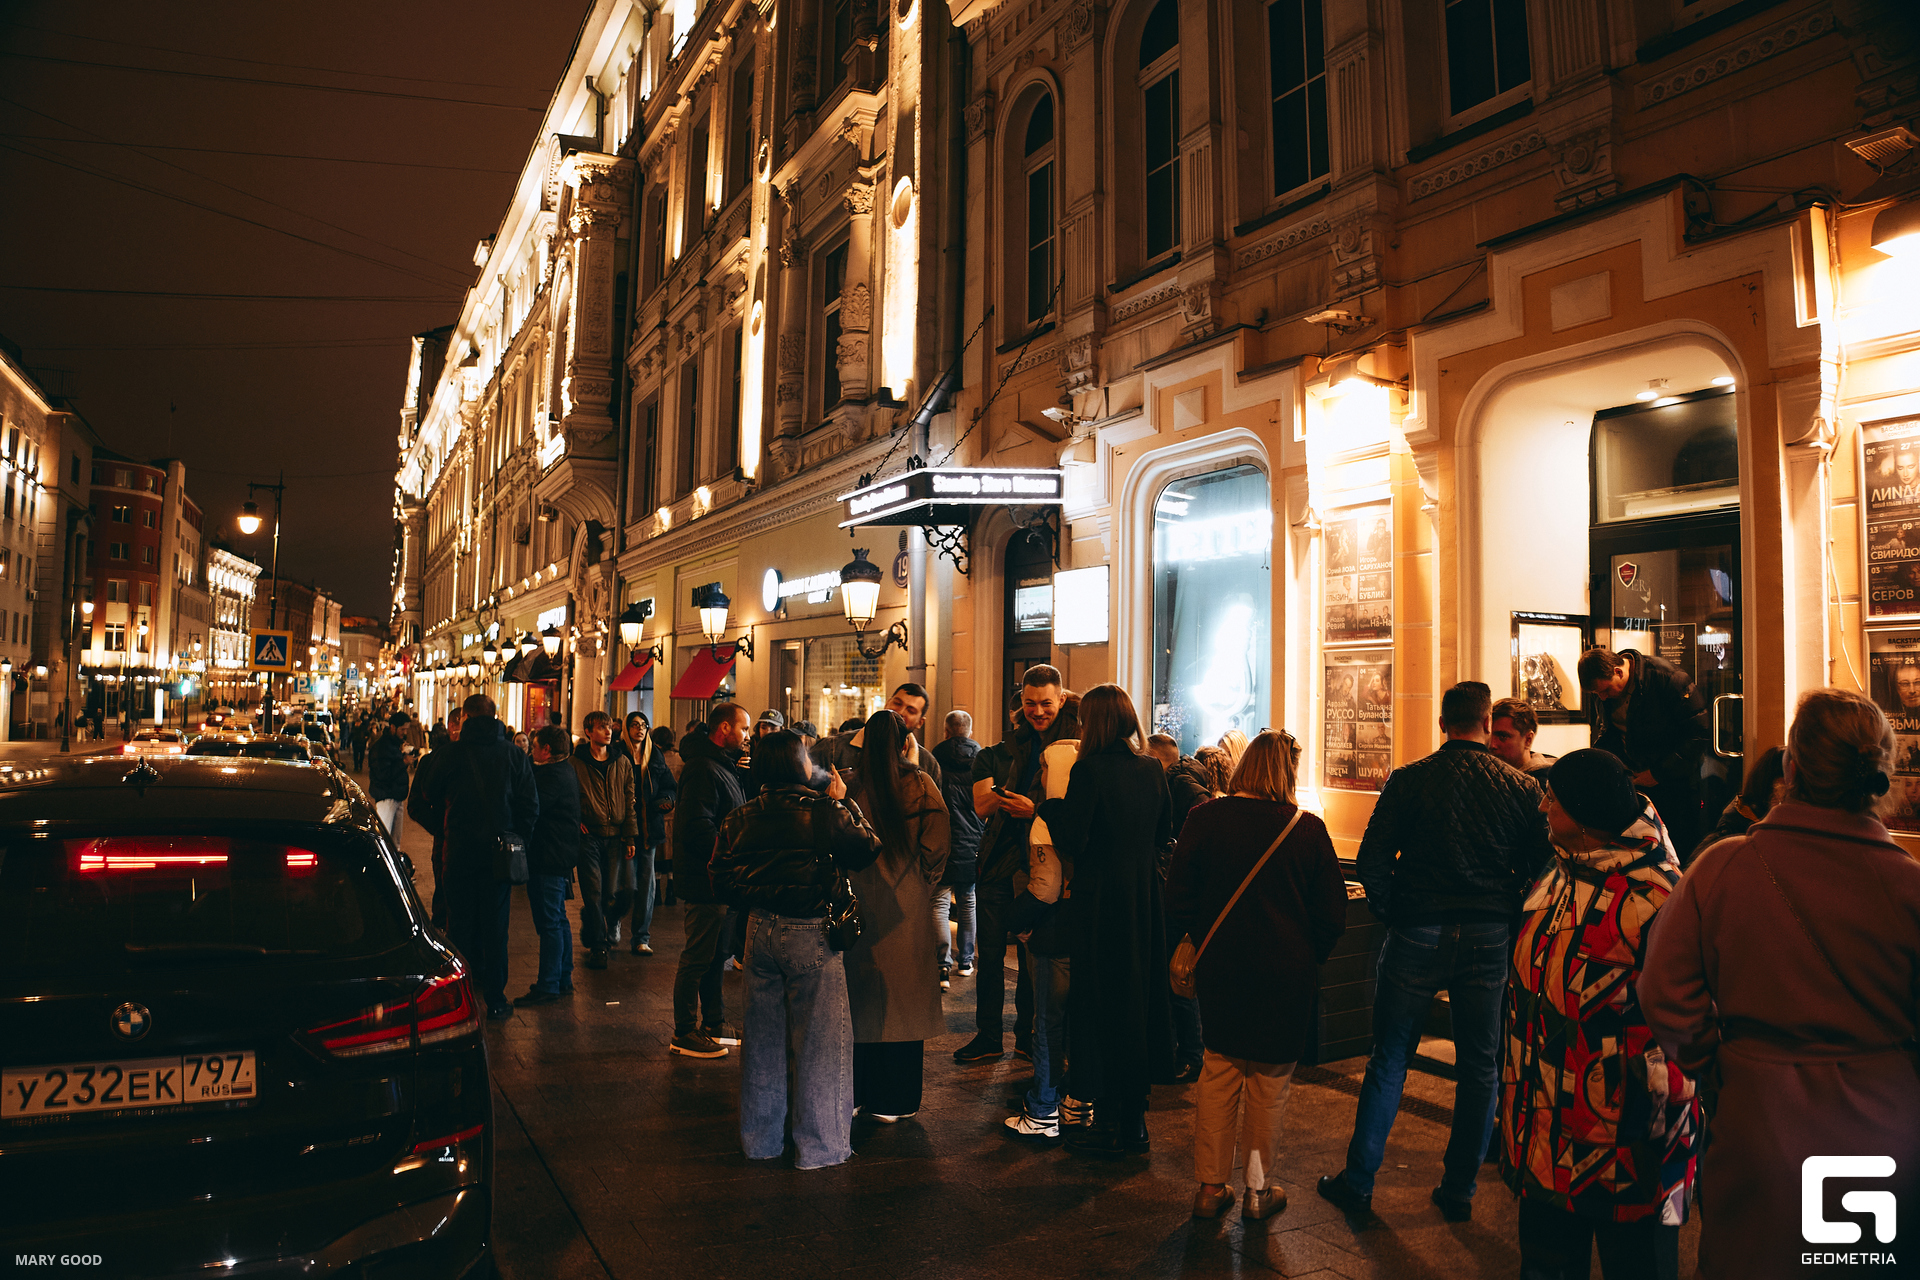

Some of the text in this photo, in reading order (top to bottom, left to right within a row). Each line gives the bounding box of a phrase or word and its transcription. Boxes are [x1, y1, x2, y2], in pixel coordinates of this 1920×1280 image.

[1881, 422, 1918, 433] BACKSTAGE
[1866, 447, 1876, 455] 06
[1901, 442, 1911, 450] 27
[1869, 526, 1879, 534] 13
[1902, 522, 1913, 530] 09
[897, 555, 909, 578] 19
[1871, 566, 1881, 574] 03
[1359, 590, 1385, 600] БУБЛИК
[1871, 588, 1915, 602] СЕРОВ
[1904, 657, 1915, 665] 26
[1326, 708, 1355, 719] РУССО
[1358, 766, 1384, 778] ШУРА
[185, 1053, 245, 1088] 797
[201, 1084, 230, 1097] RUS
